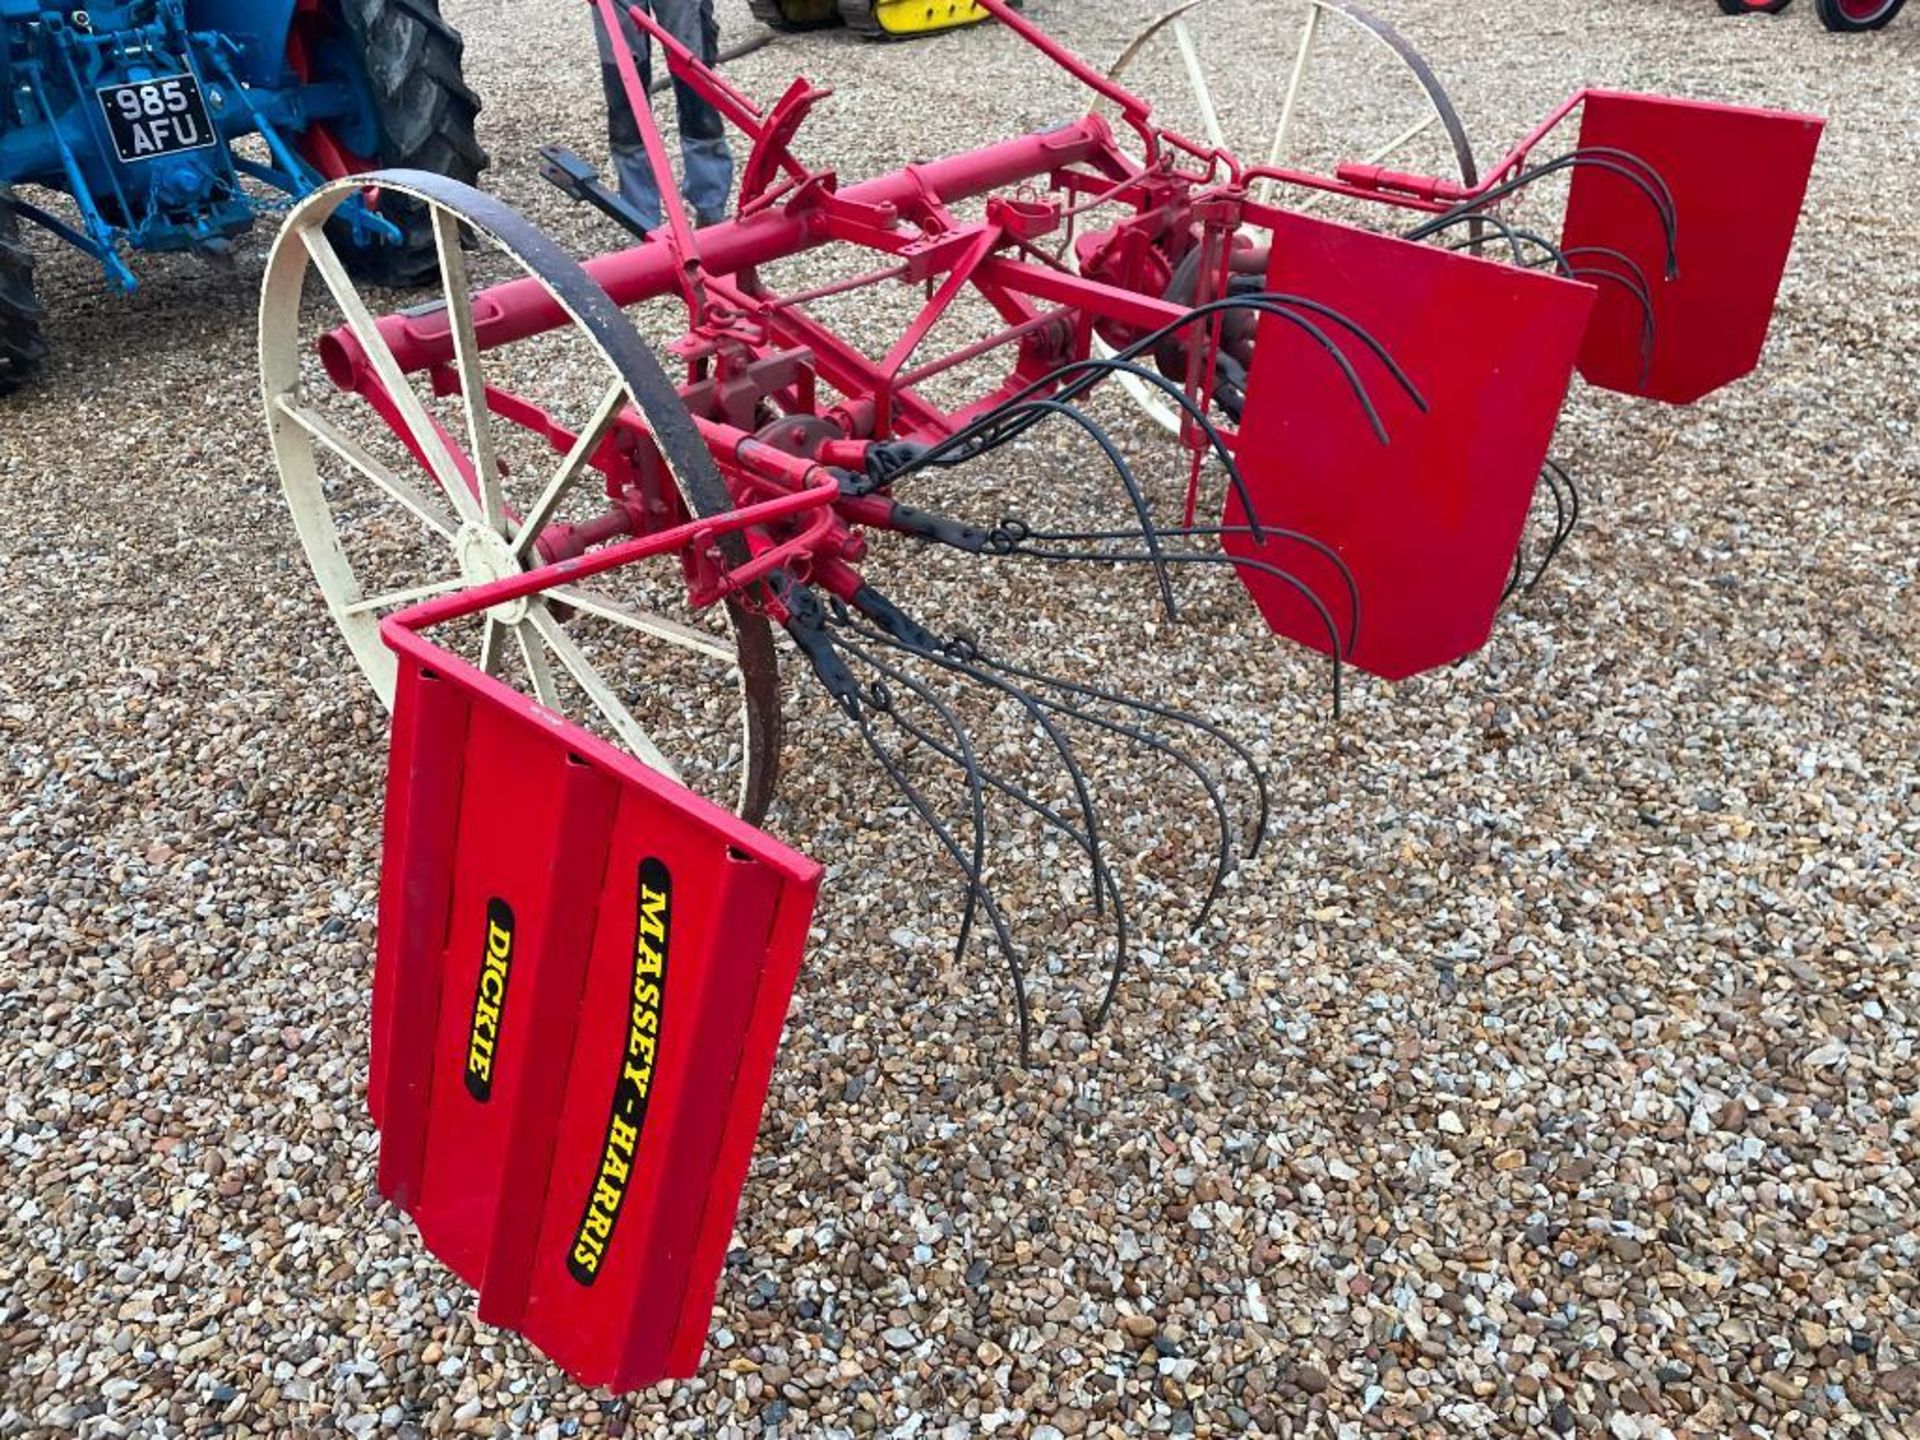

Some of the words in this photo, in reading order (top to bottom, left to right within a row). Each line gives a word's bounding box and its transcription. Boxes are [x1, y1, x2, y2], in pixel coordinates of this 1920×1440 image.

[116, 81, 188, 120] 985
[132, 113, 198, 154] AFU
[469, 919, 512, 1083] DICKIE
